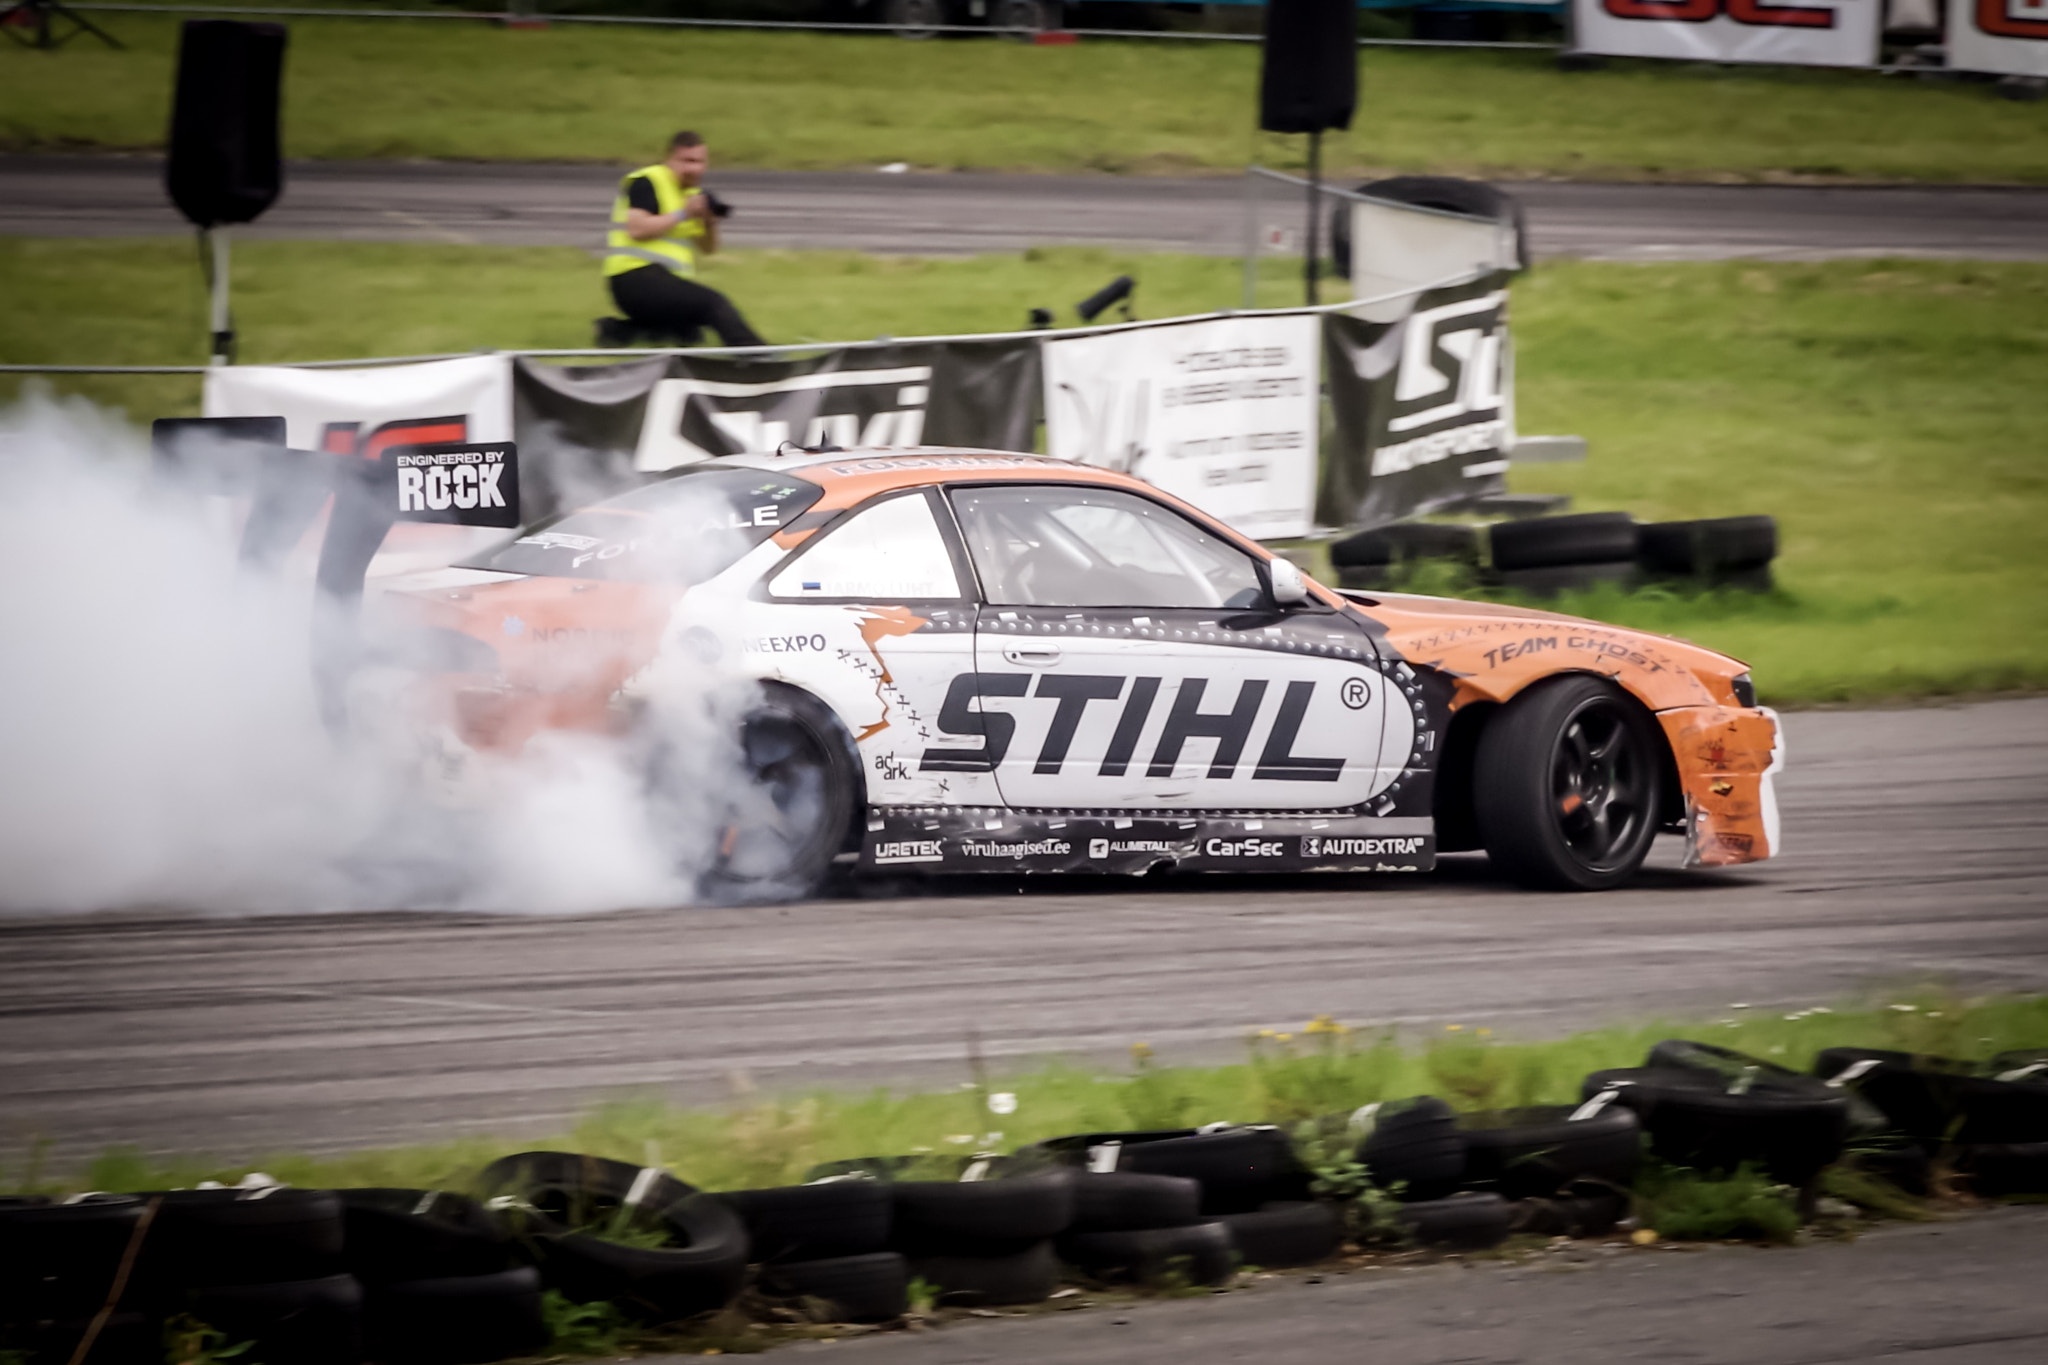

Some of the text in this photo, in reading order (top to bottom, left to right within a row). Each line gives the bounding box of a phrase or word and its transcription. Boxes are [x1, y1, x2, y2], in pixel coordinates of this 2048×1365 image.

[397, 451, 505, 467] ENGINEERED BY
[398, 463, 506, 512] ROCK
[1483, 636, 1666, 673] TEAM GHOST
[919, 673, 1347, 782] STIHL
[875, 840, 943, 858] URETEK
[961, 839, 1071, 860] viruhaagised.ee
[1206, 838, 1284, 857] CarSec
[1322, 838, 1417, 855] AUTOEXTRA
